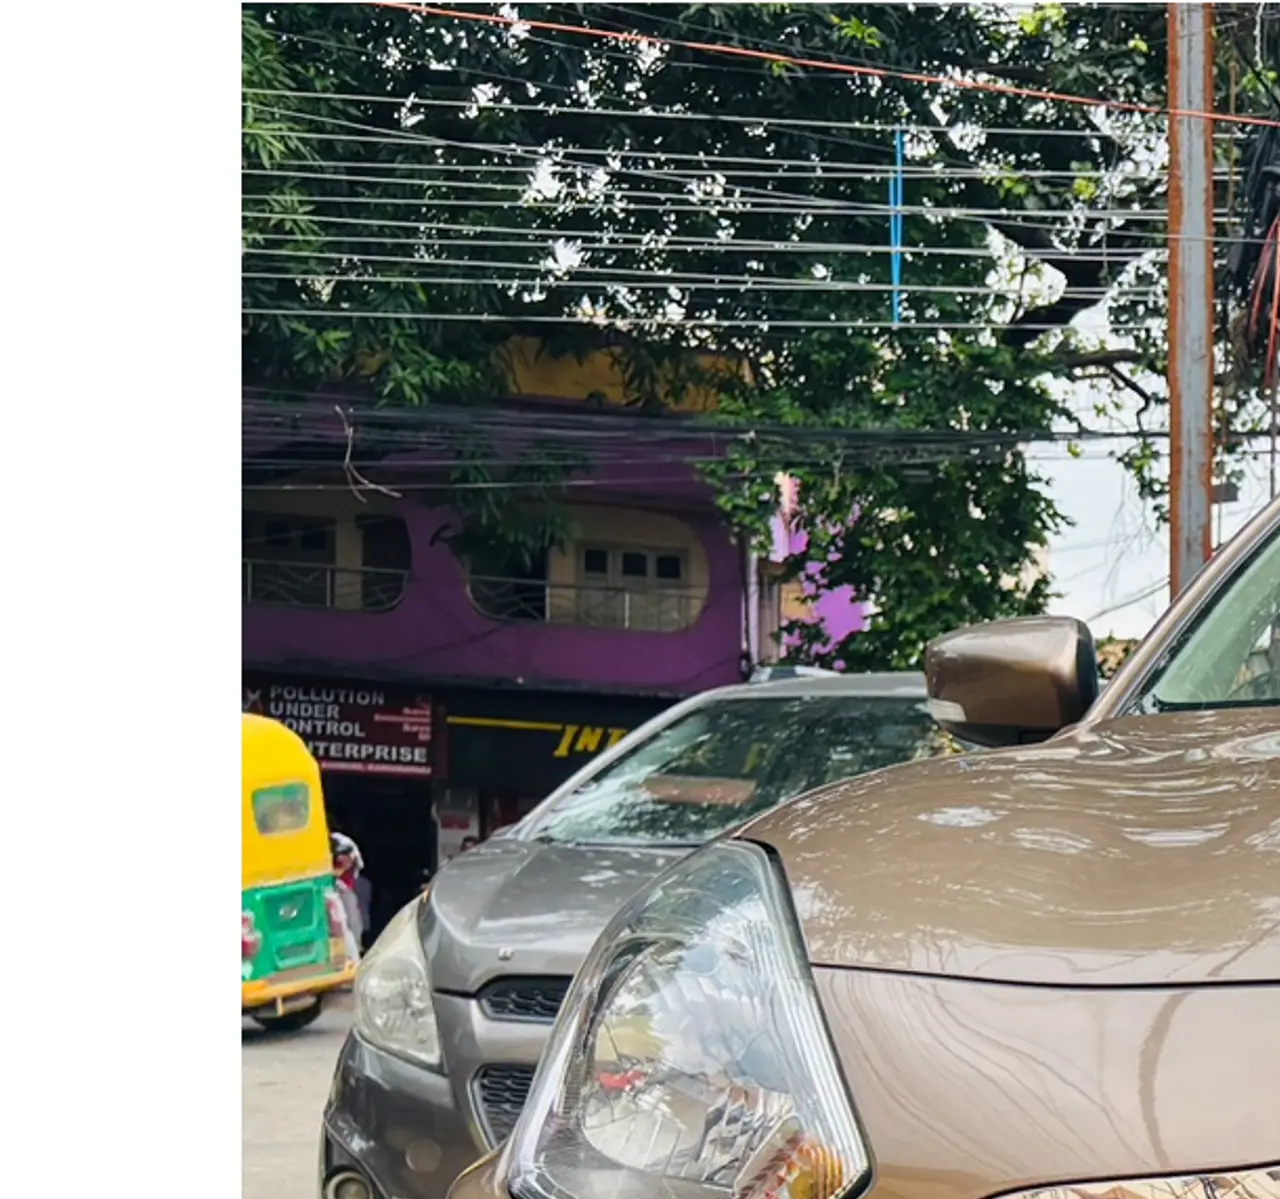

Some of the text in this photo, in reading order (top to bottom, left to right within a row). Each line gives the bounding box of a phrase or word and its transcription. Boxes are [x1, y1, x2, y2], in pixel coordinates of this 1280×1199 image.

[269, 685, 385, 706] POLLUTION
[269, 702, 341, 720] UNDER
[281, 717, 366, 738] ONTROL
[308, 741, 428, 762] TERPRISE
